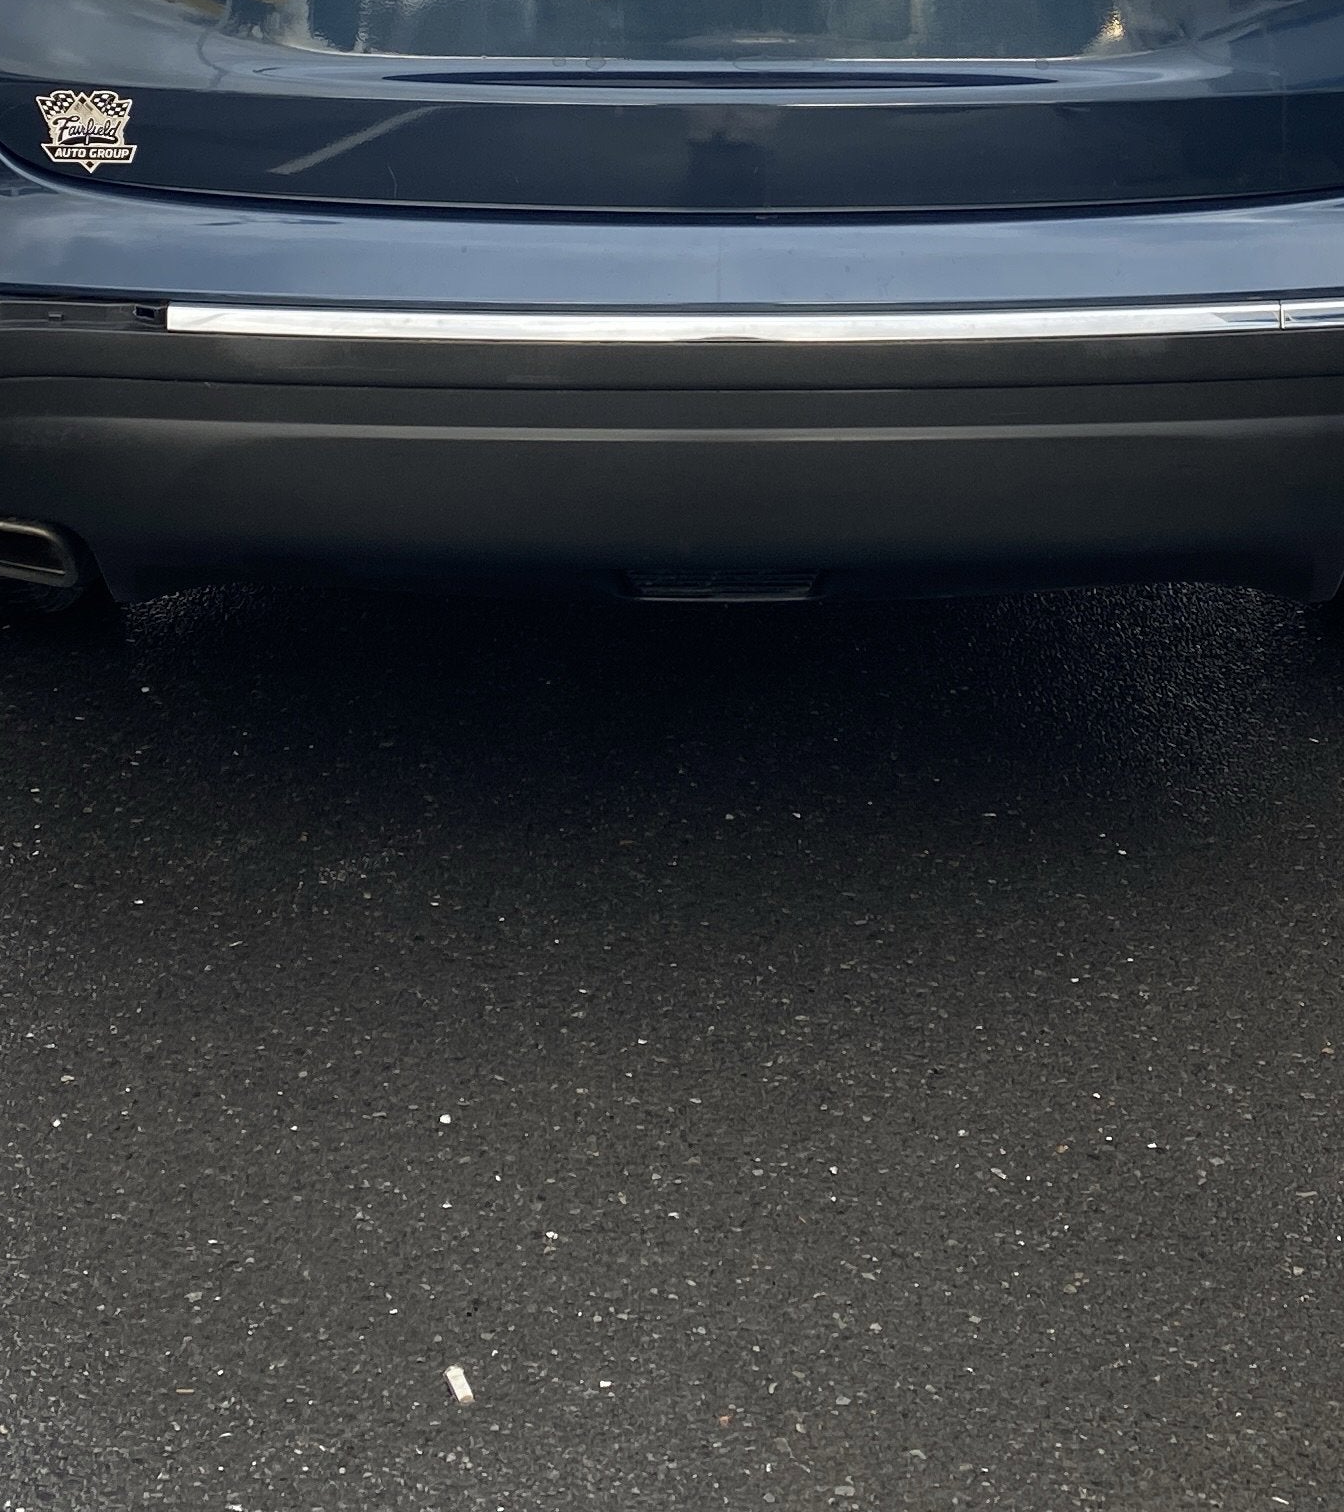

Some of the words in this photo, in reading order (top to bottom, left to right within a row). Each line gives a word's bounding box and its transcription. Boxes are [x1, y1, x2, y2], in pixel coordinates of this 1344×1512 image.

[52, 115, 123, 141] Fairfield
[55, 147, 86, 159] AUTO
[89, 147, 130, 159] GROUP
